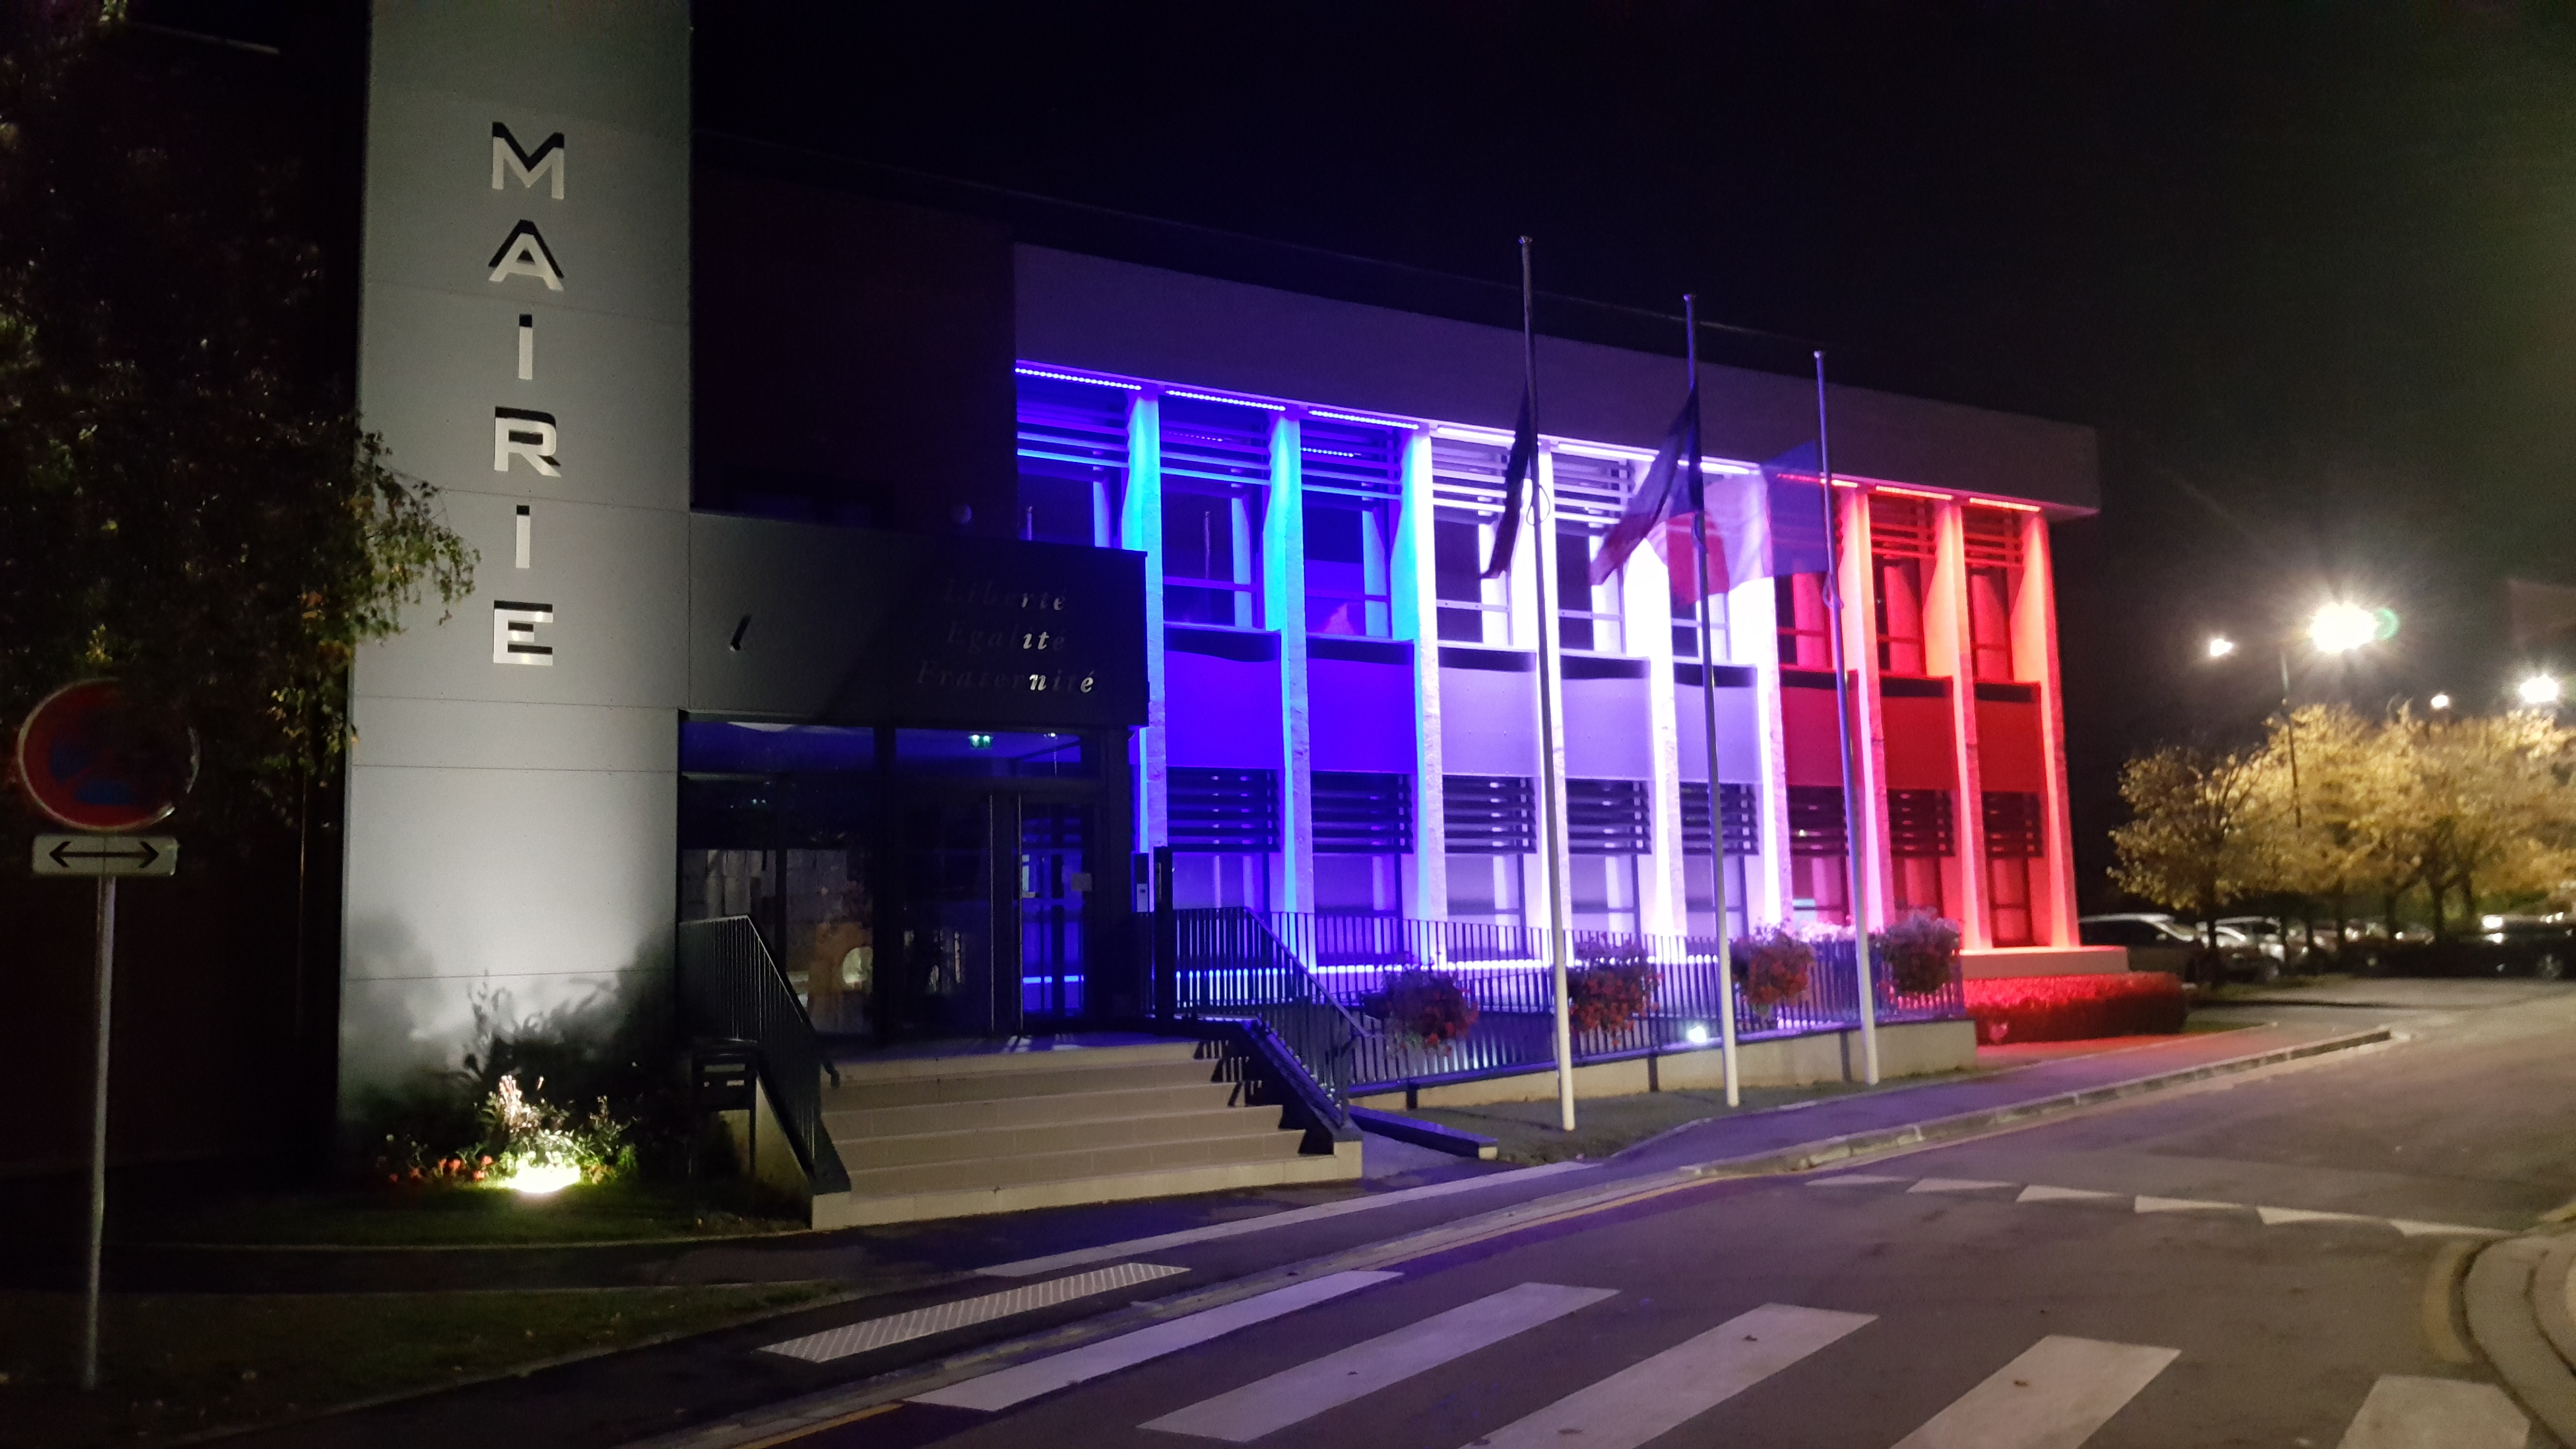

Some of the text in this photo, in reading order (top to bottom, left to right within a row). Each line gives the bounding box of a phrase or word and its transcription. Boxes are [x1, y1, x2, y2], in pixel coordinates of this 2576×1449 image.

[488, 125, 565, 666] MAIRIE
[944, 578, 1066, 611] Liberté
[917, 660, 1095, 693] Fraternité
